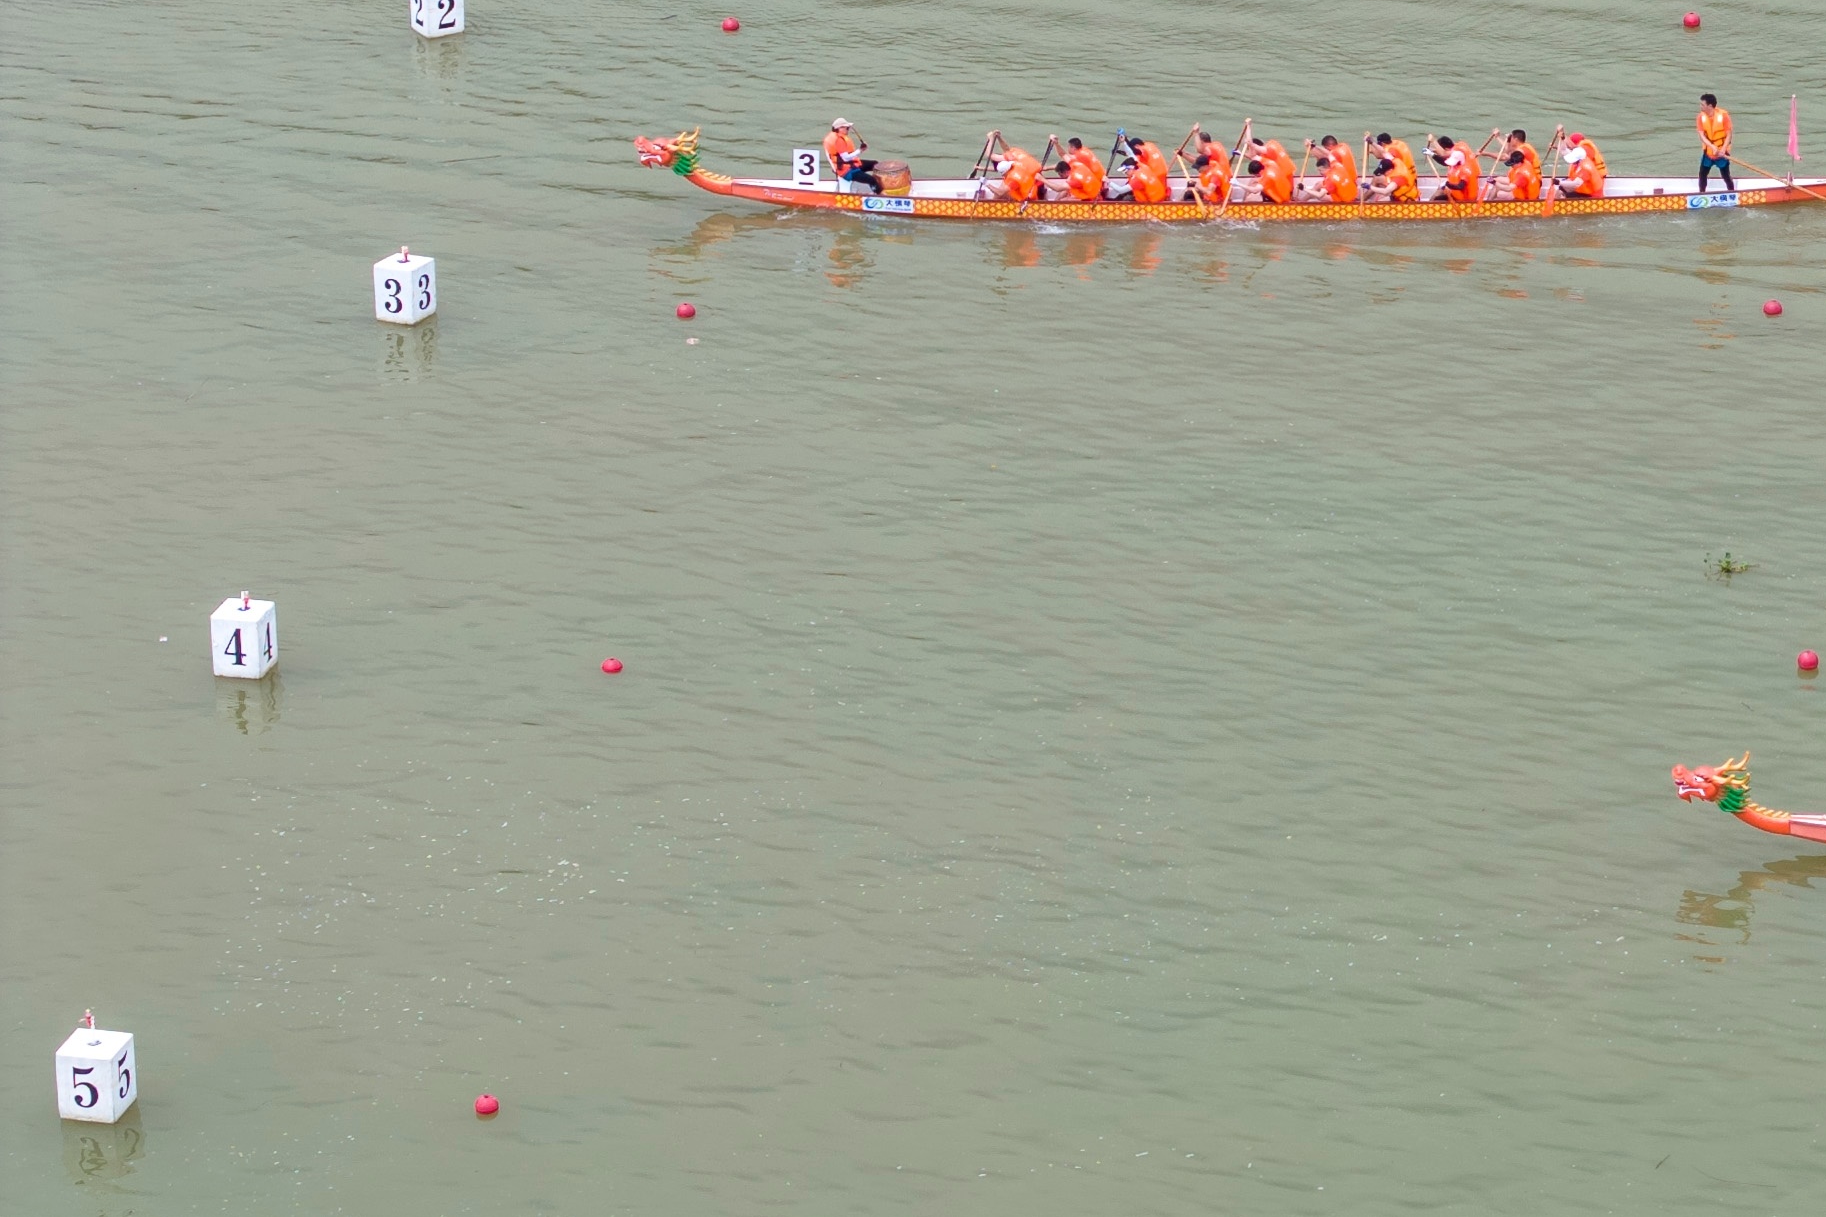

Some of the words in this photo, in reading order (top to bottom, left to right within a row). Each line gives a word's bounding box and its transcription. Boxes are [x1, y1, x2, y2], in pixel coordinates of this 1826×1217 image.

[797, 154, 817, 177] 3
[383, 278, 404, 314] 3
[418, 273, 432, 311] 3
[223, 628, 247, 666] 4
[262, 621, 273, 663] 4
[71, 1066, 99, 1109] 5
[117, 1050, 131, 1100] 5
